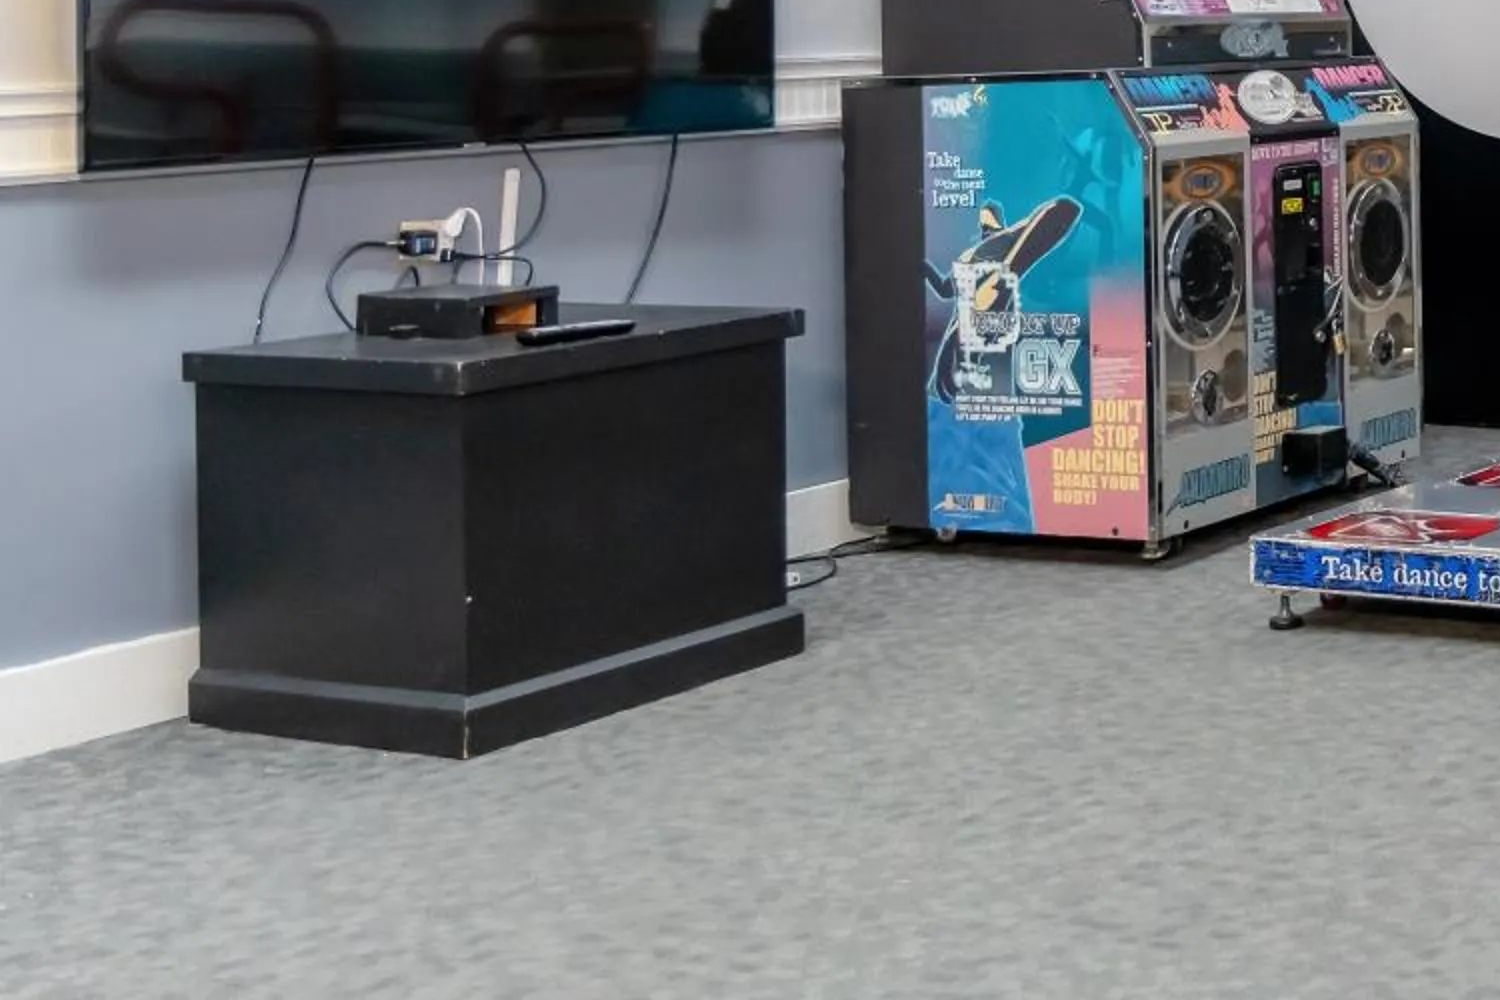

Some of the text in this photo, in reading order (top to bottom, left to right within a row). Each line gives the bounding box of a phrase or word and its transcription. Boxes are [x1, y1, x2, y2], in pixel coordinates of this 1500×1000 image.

[927, 151, 961, 168] Take
[932, 190, 976, 207] level
[1050, 312, 1081, 336] UP
[1013, 337, 1082, 396] GX
[1093, 399, 1144, 423] DON'T
[1093, 424, 1140, 448] STOP
[1053, 448, 1145, 475] DANCING!
[1053, 473, 1140, 491] SHAKE YOUR
[1320, 555, 1384, 583] Take
[1393, 562, 1468, 591] dance
